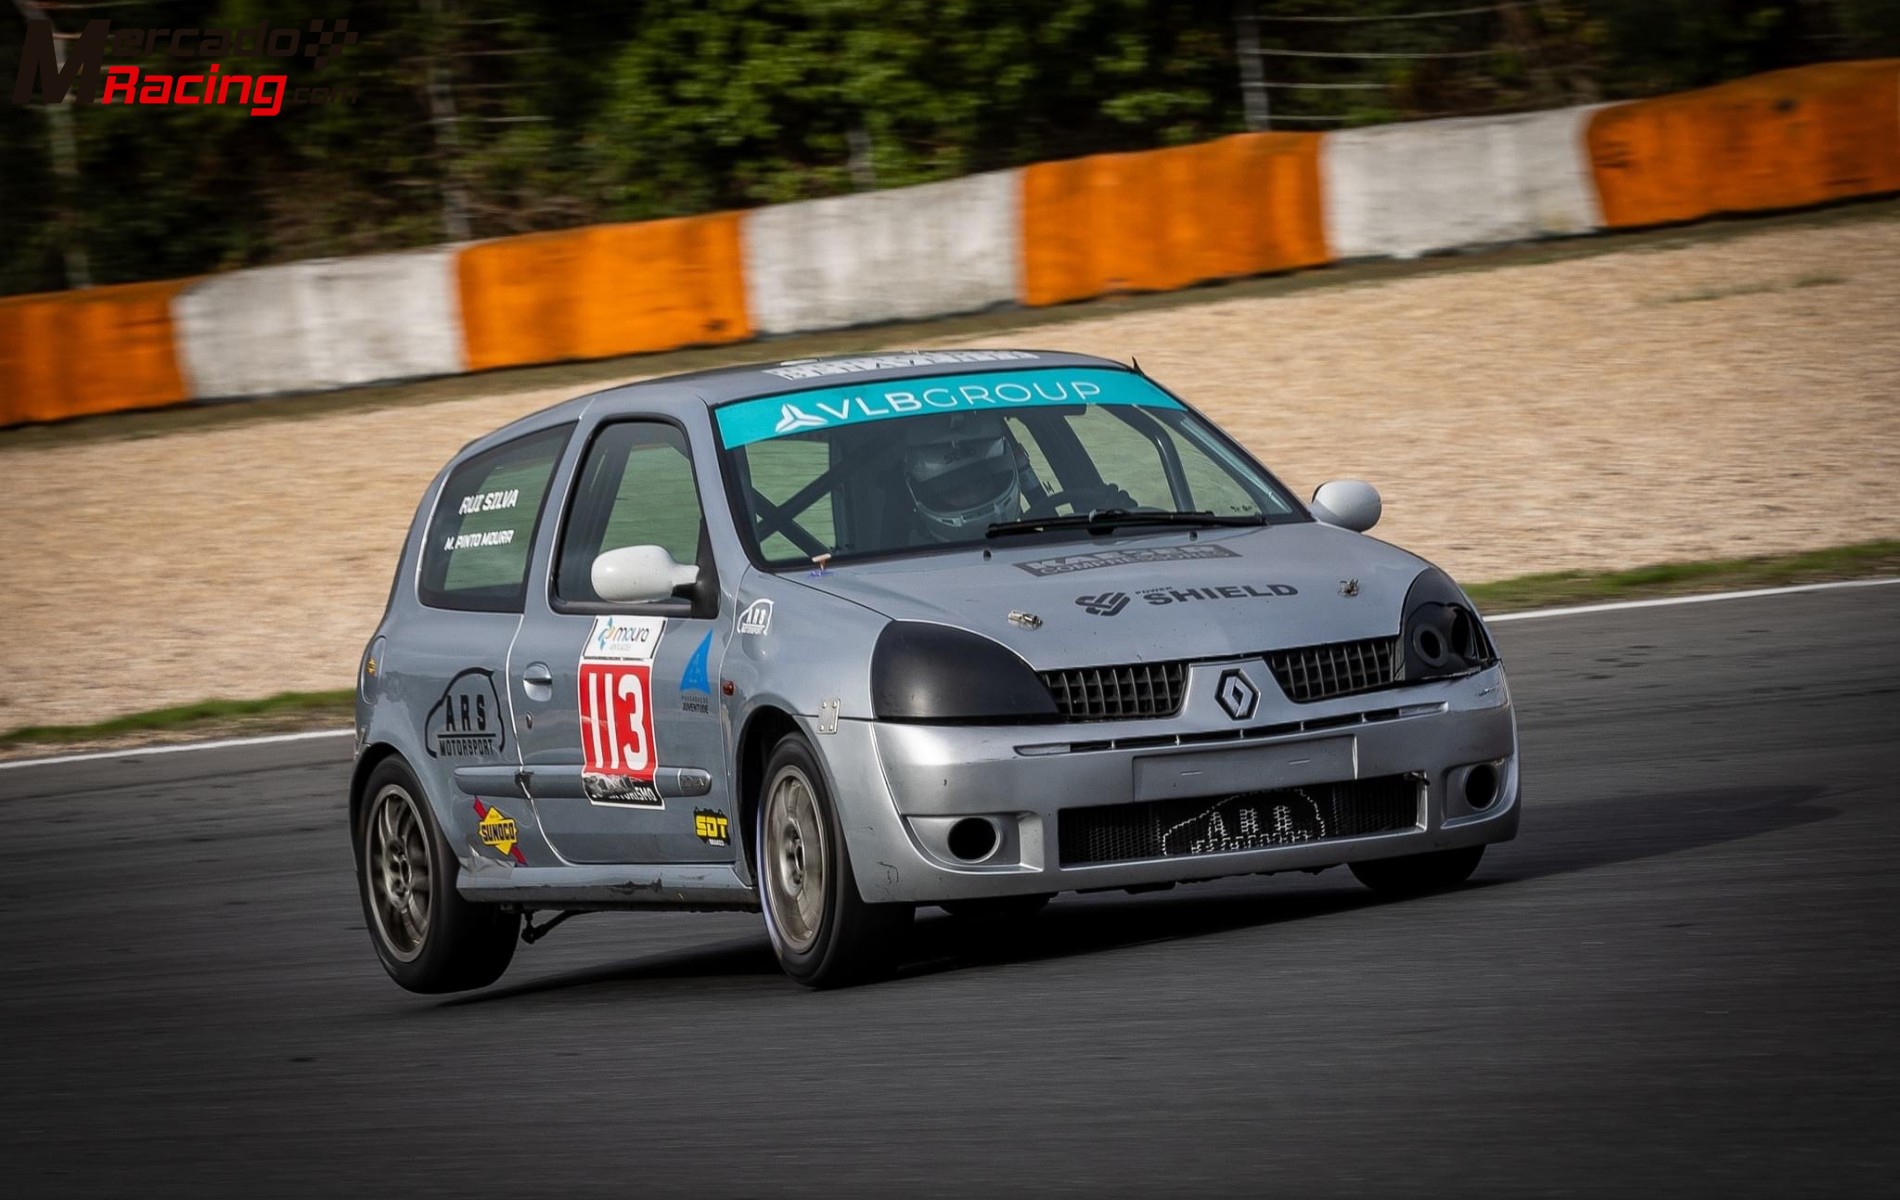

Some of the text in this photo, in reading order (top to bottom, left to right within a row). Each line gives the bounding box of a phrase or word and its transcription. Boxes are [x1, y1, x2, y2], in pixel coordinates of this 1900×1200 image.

[816, 381, 1100, 421] VLBGROUP
[458, 489, 519, 515] RUI SILVA
[455, 533, 482, 549] PINTO
[1143, 584, 1299, 606] SHIELD
[613, 626, 650, 643] moura
[445, 694, 487, 732] ARS
[589, 671, 649, 771] 113
[439, 738, 494, 757] MOTORSPORT
[481, 822, 516, 843] SUNOCO
[695, 815, 728, 839] SDT
